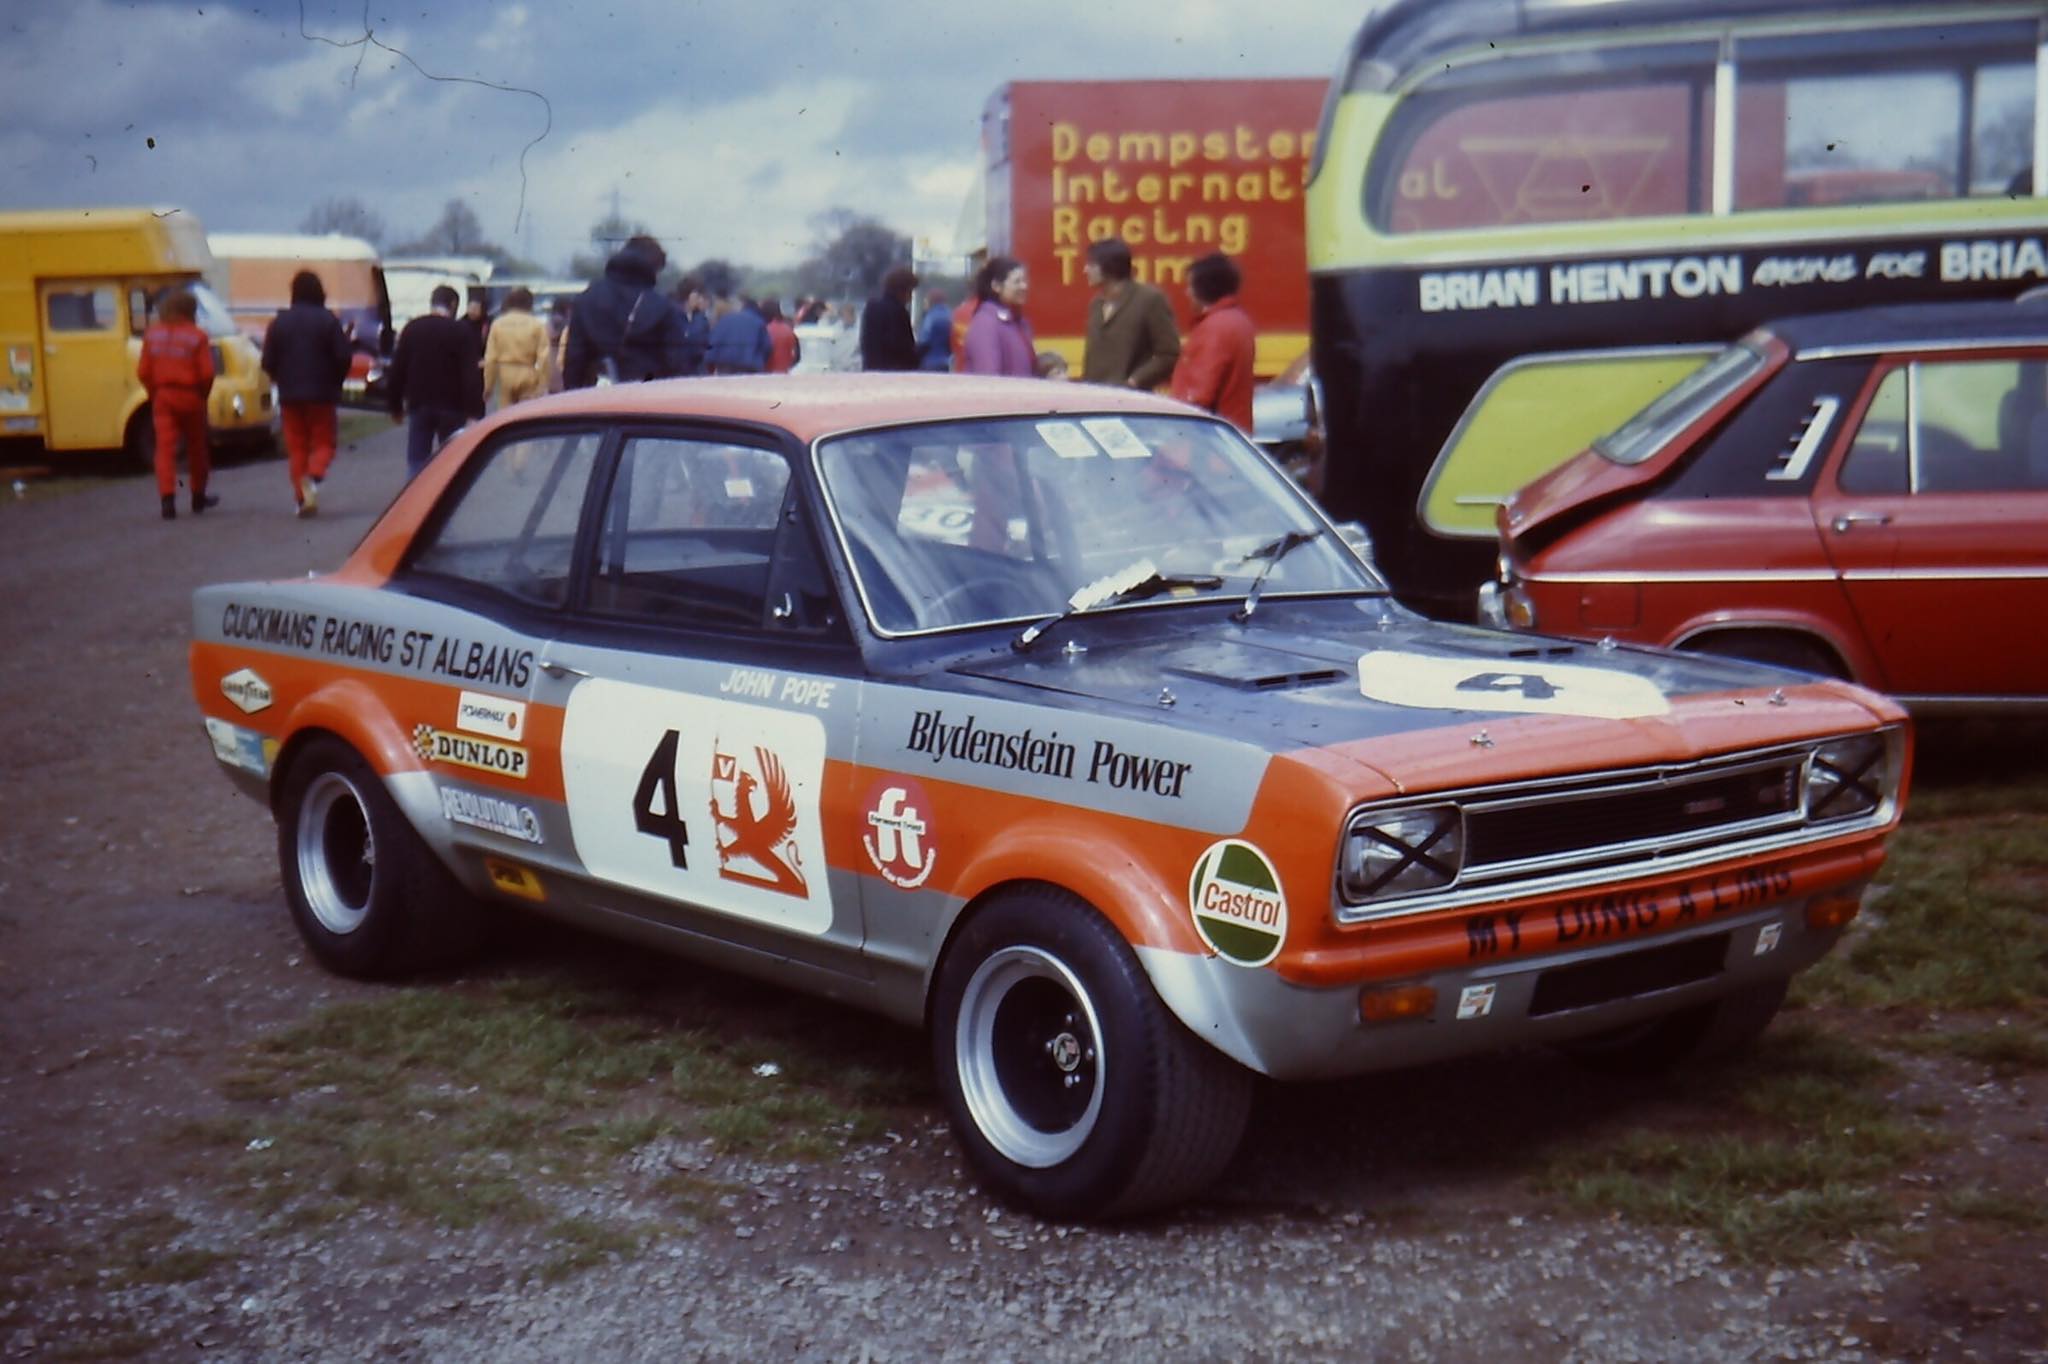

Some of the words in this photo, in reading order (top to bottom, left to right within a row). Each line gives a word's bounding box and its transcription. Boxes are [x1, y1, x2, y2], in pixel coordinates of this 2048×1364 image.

[1053, 125, 1316, 168] Dempster
[1053, 205, 1249, 256] Racing
[1053, 248, 1195, 286] Tam
[1419, 270, 1537, 313] BRIAN
[1551, 255, 1742, 304] HENTON
[1940, 237, 2048, 282] BRIA
[320, 616, 396, 664] RACING
[400, 629, 434, 671] ST
[432, 635, 534, 689] ALBANS
[719, 668, 777, 699] JOHN
[780, 676, 836, 709] POPE
[1455, 672, 1565, 699] 4
[437, 735, 525, 773] DUNLOP
[906, 709, 1076, 780] Blydenstein
[1087, 739, 1192, 799] Power
[632, 728, 690, 871] 4
[1203, 882, 1282, 928] Castrol
[1466, 909, 1524, 958] MY
[1555, 892, 1662, 943] DING
[1674, 884, 1697, 922] A
